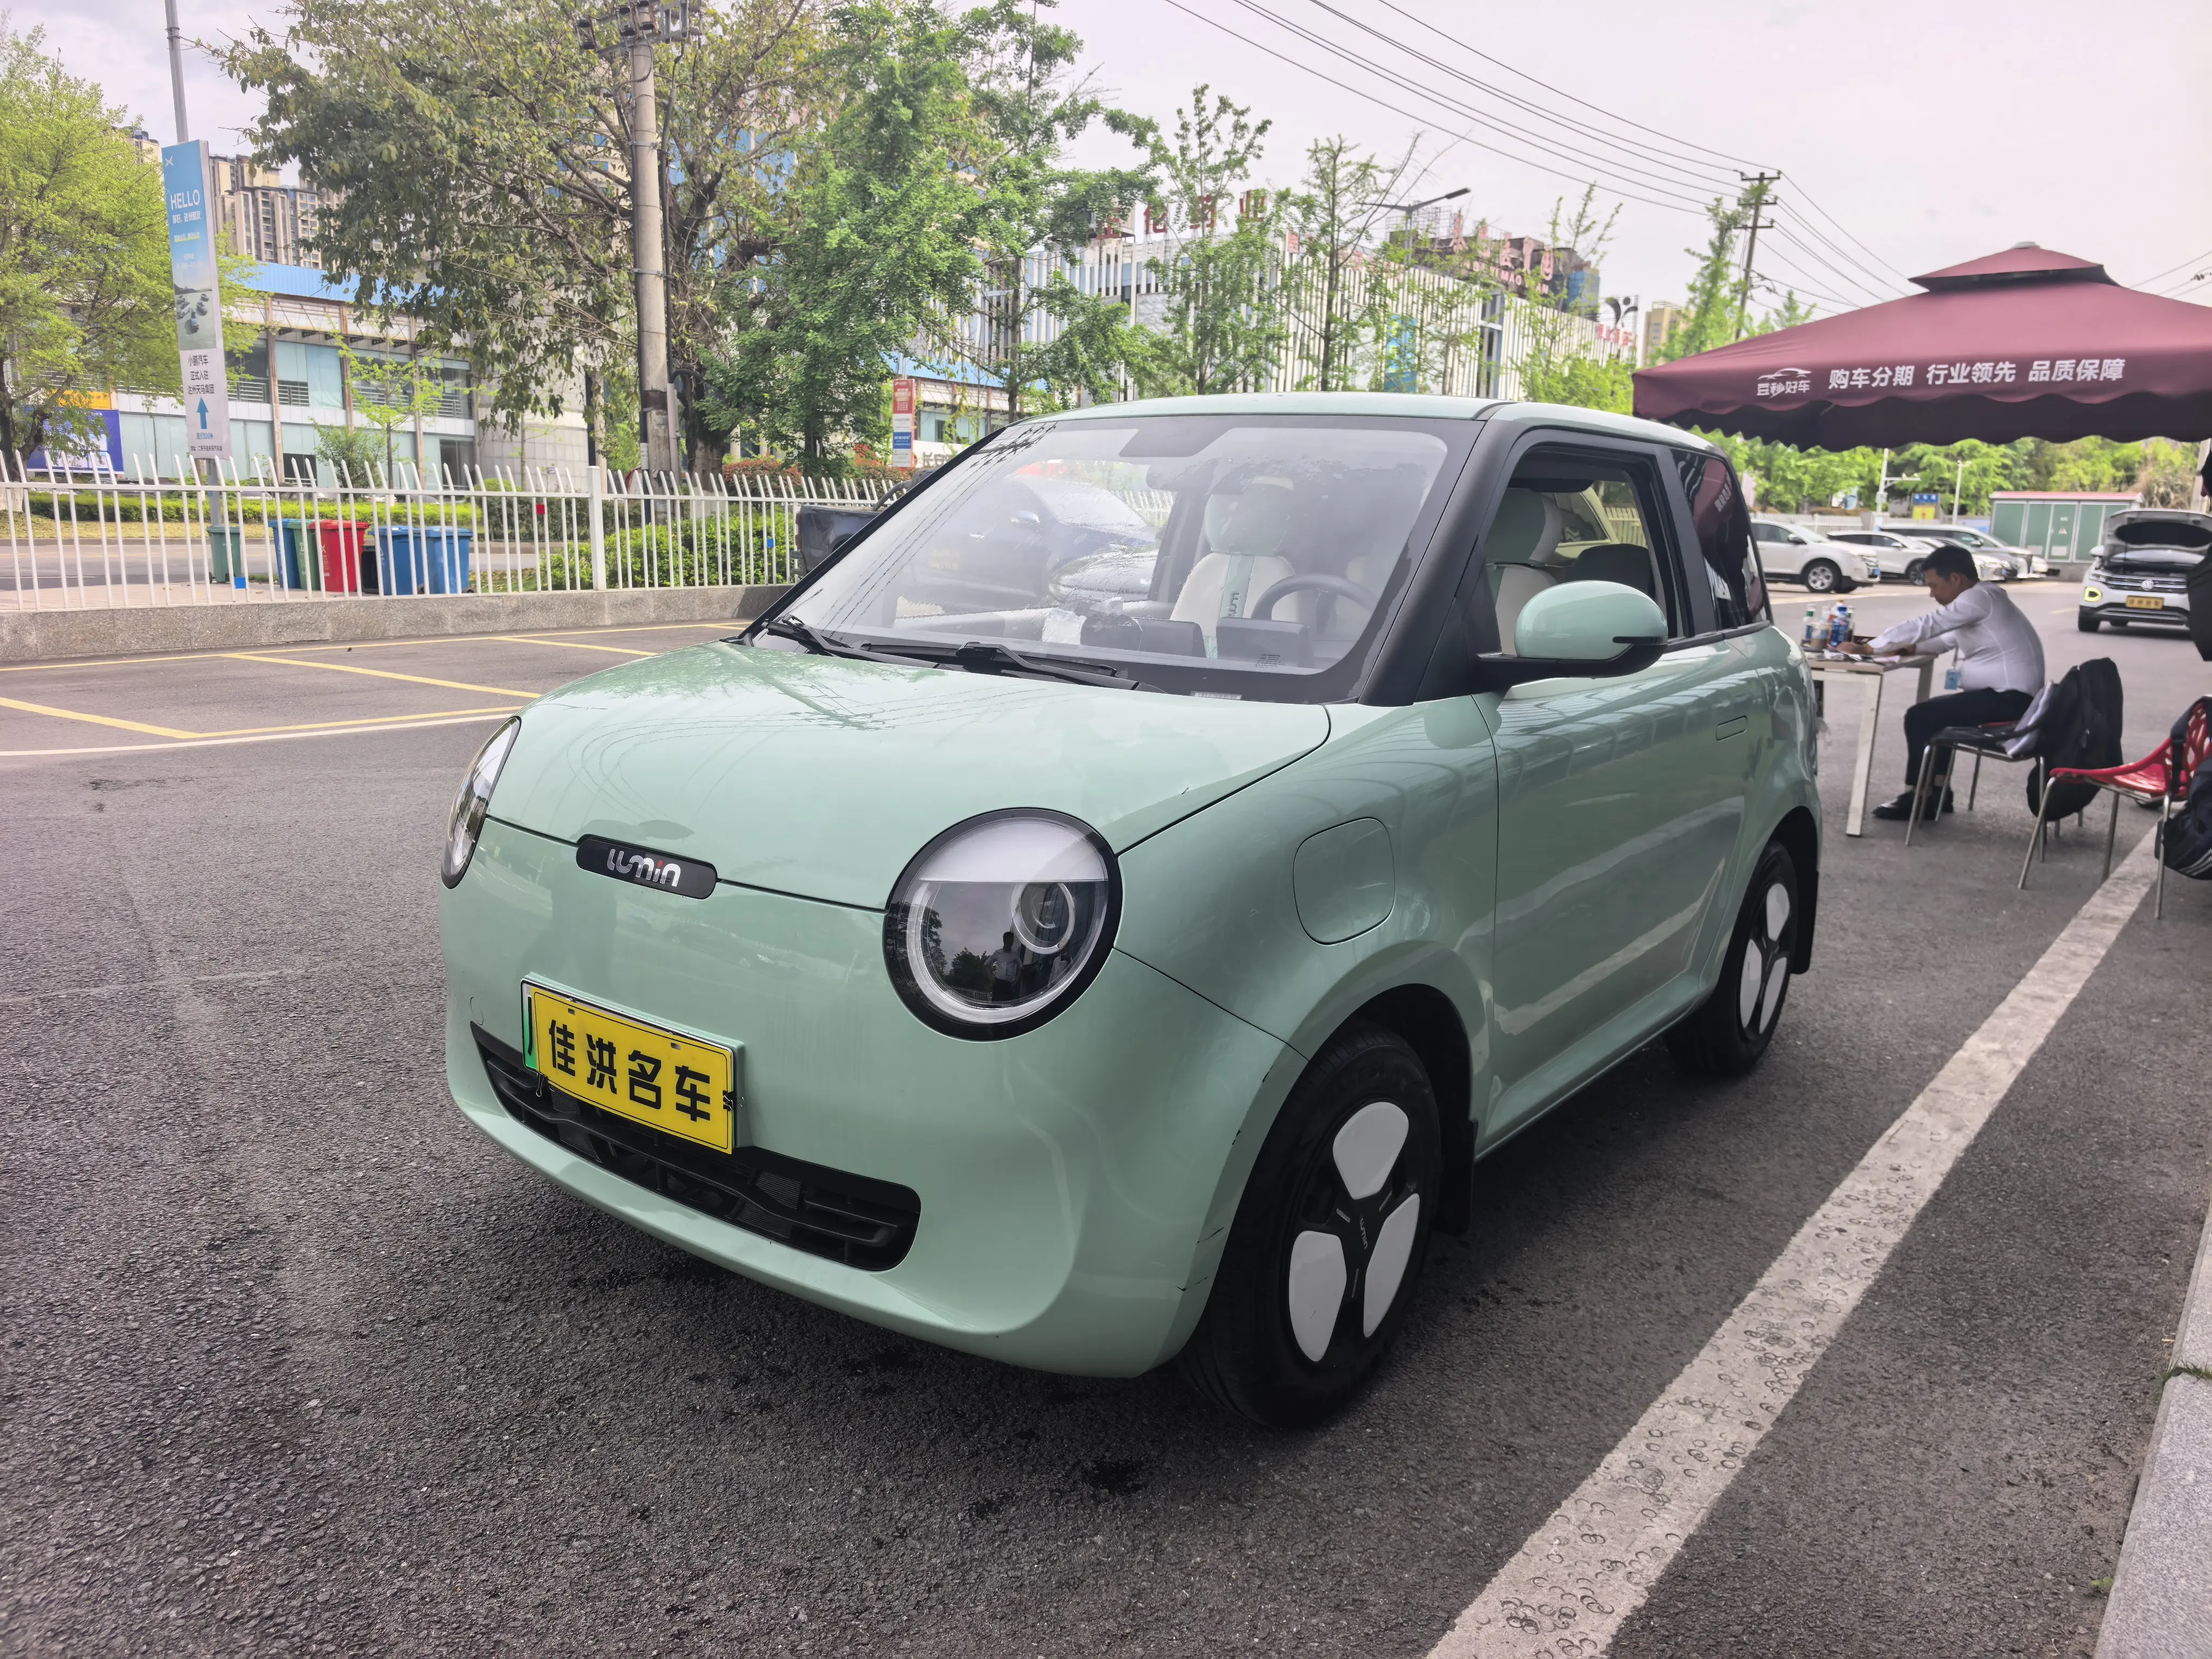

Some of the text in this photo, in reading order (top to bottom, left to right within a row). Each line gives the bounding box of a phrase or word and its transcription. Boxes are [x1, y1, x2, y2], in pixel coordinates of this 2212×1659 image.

[170, 189, 200, 210] HELLO
[1828, 365, 1915, 389] 购车分期
[1926, 361, 2017, 385] 行业领先
[2028, 359, 2126, 382] 品质保障
[548, 1019, 711, 1122] 佳洪名车
